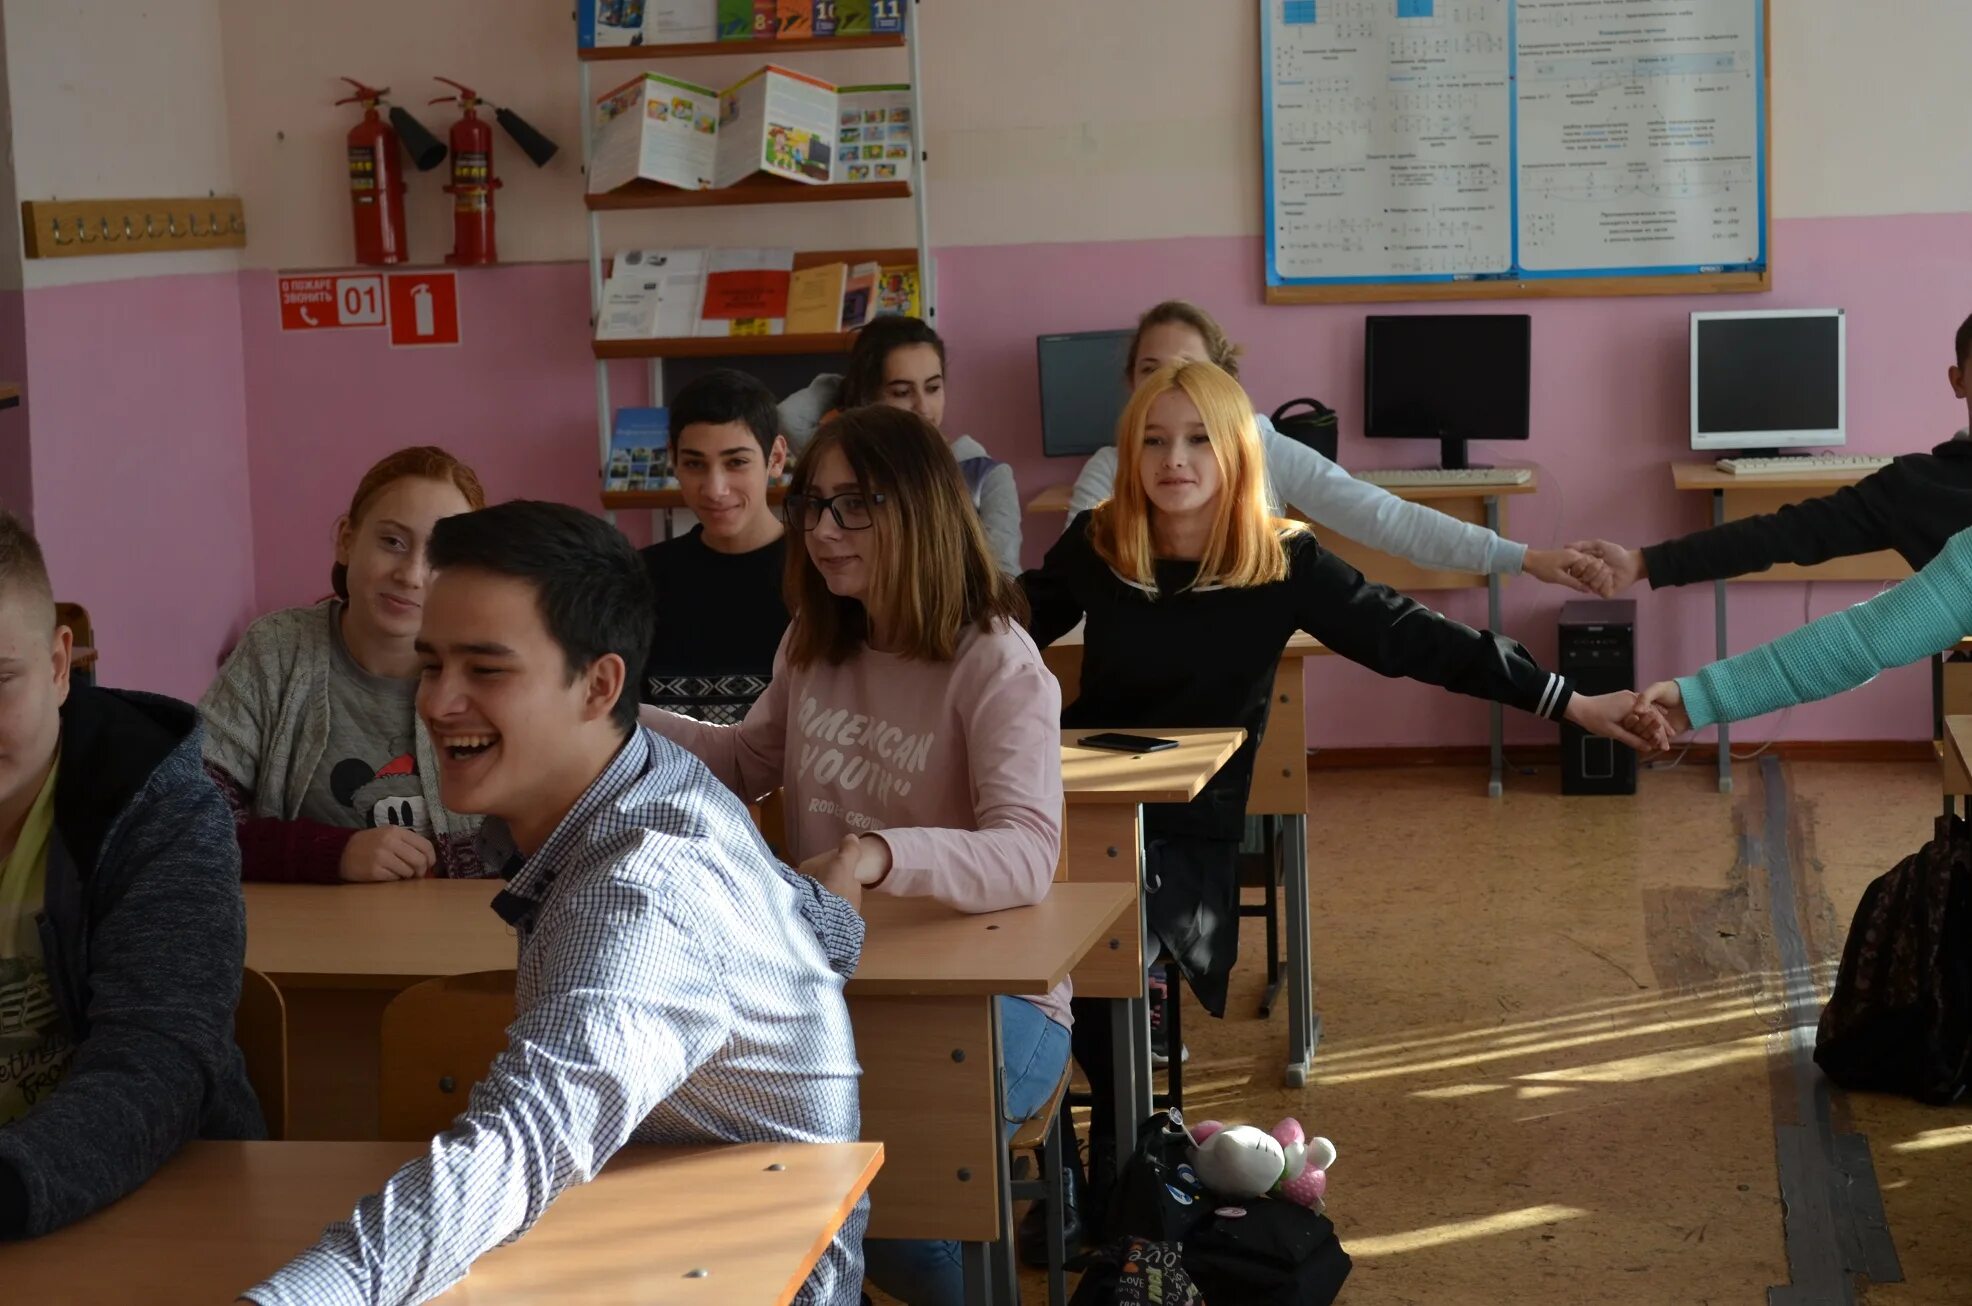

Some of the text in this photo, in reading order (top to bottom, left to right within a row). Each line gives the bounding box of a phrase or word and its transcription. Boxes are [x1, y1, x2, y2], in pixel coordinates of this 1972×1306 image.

[873, 0, 901, 18] 11
[282, 279, 332, 292] О ПОЖАРЕ
[283, 292, 333, 304] ЗВОНИТЬ
[345, 286, 375, 315] 01
[1119, 1275, 1145, 1289] LOVE
